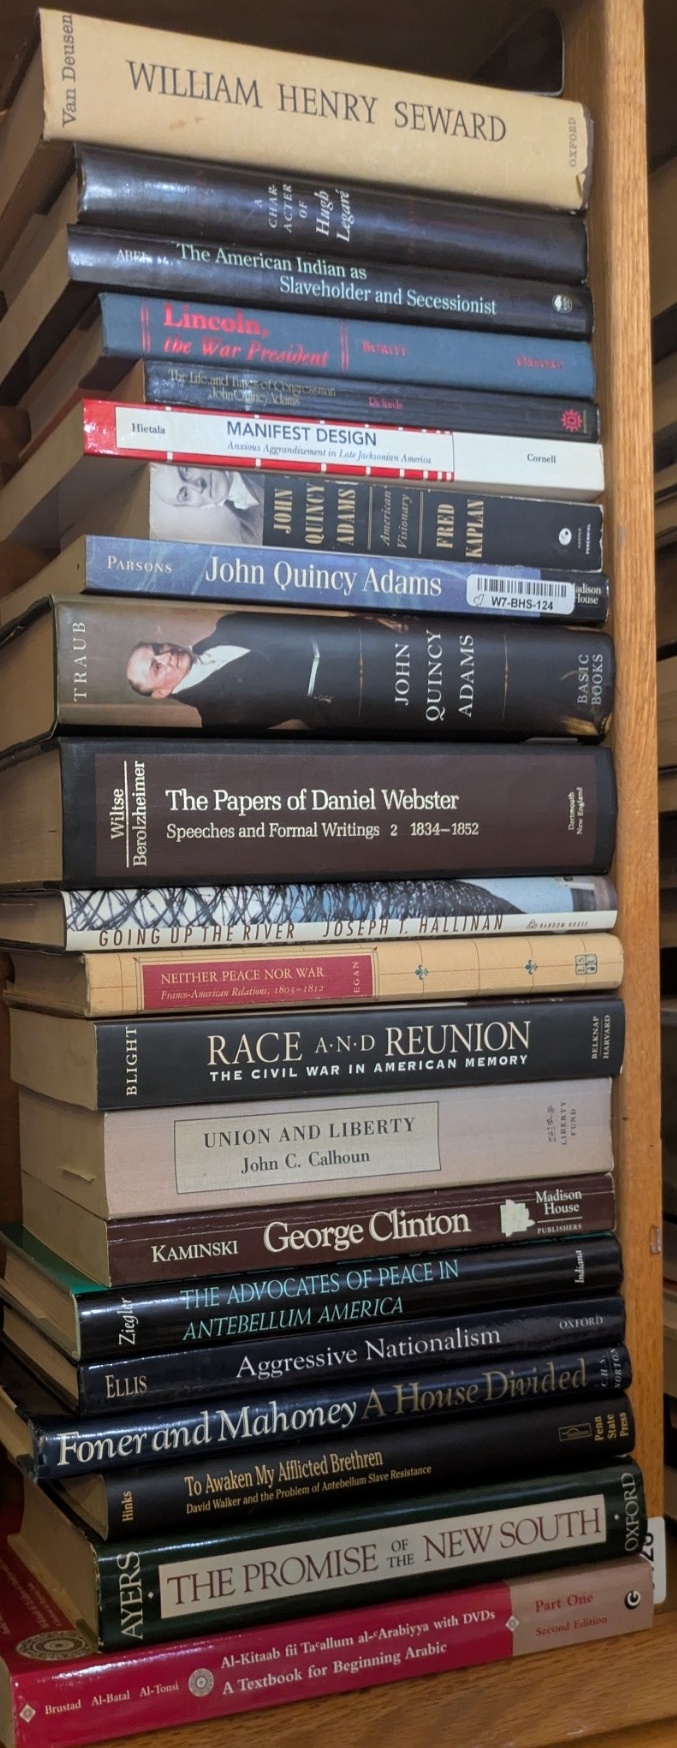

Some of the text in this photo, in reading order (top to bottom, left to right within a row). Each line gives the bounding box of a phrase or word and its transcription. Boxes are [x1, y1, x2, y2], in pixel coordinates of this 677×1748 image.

[62, 14, 77, 128] Van Deusen
[125, 60, 507, 142] WILLIAM HENRY SEWARD
[176, 243, 367, 279] The American Indian as
[280, 275, 497, 315] Slaveholder and Secessionist
[163, 303, 269, 338] Lincoln,
[163, 335, 328, 367] the War President
[131, 422, 166, 435] Hietala
[226, 420, 377, 446] MANIFEST DESIGN
[227, 441, 432, 464] Anxious Aggrandizement Late America
[527, 453, 556, 464] Cornell
[273, 488, 293, 535] JOHN
[305, 482, 324, 545] QUINCY
[336, 488, 356, 546] ADAMS
[396, 493, 413, 549] Visionary
[436, 503, 455, 548] FRED
[465, 499, 484, 558] KAPLAN
[205, 556, 442, 596] John Quincy Adams
[491, 596, 553, 610] W7-BHS-124
[72, 622, 87, 702] TRAUB
[395, 643, 410, 706] JOHN
[425, 629, 445, 721] QUINCY
[458, 634, 474, 718] ADAMS
[577, 654, 589, 704] BASIC
[591, 653, 603, 706] BOOKS
[109, 788, 125, 839] Wiltse
[132, 760, 147, 866] Berolzheimer
[165, 787, 459, 816] The Papers of Daniel Webster
[166, 822, 380, 842] Speeches and Formal Writings
[99, 923, 295, 947] GOING UP THE RIVER
[322, 914, 504, 937] JOSEPH HALLINAN
[161, 967, 325, 984] NEITHER PEACE NOR WAR
[161, 986, 270, 999] Franco-American Relations,
[352, 961, 360, 993] EGAN
[207, 1020, 531, 1066] RACE REUNION
[603, 1014, 611, 1059] HARVARD
[125, 1026, 138, 1096] BLIGHT
[210, 1055, 528, 1082] THE CIVIL WAR IN AMERICAN MEMORY
[203, 1117, 416, 1148] UNION AND LIBERTY
[241, 1150, 370, 1174] John C. Calhoun
[536, 1188, 582, 1203] Madison
[544, 1202, 579, 1215] House
[263, 1208, 471, 1253] George Clinton
[537, 1224, 582, 1234] PUBLISHERS
[151, 1240, 239, 1262] KAMINSKI
[575, 1250, 584, 1283] Indiana
[180, 1259, 459, 1309] THE ADVOCATES OF PEACE IN
[117, 1297, 139, 1345] Ziegler
[182, 1296, 404, 1341] ANTEBELLUM AMERICA
[559, 1316, 603, 1330] OXFORD
[236, 1328, 501, 1380] Aggressive Nationalism
[361, 1357, 588, 1419] A House Divided
[56, 1400, 356, 1466] Foner and Mahoney
[594, 1416, 602, 1441] Penn
[607, 1414, 615, 1439] State
[619, 1412, 627, 1437] Press
[184, 1450, 383, 1496] To Awaken My Afflicted Brethren
[186, 1465, 432, 1514] David Walker and the Problem Antebellum Slave Resistance
[122, 1491, 134, 1522] Hinks
[621, 1472, 641, 1552] OXFORD
[390, 1539, 409, 1551] OF
[422, 1507, 602, 1562] NEW SOUTH
[167, 1543, 380, 1605] THE PROMISE
[387, 1553, 415, 1569] THE
[117, 1551, 143, 1640] AYERS
[535, 1594, 593, 1613] Part One
[220, 1609, 496, 1669] Al-Kitaab with DVDs
[535, 1616, 608, 1637] Second Edition
[222, 1642, 447, 1696] A Textbook for Beginning Arabic
[44, 1681, 179, 1715] Brustad Al-Batal Al-Tonsi
